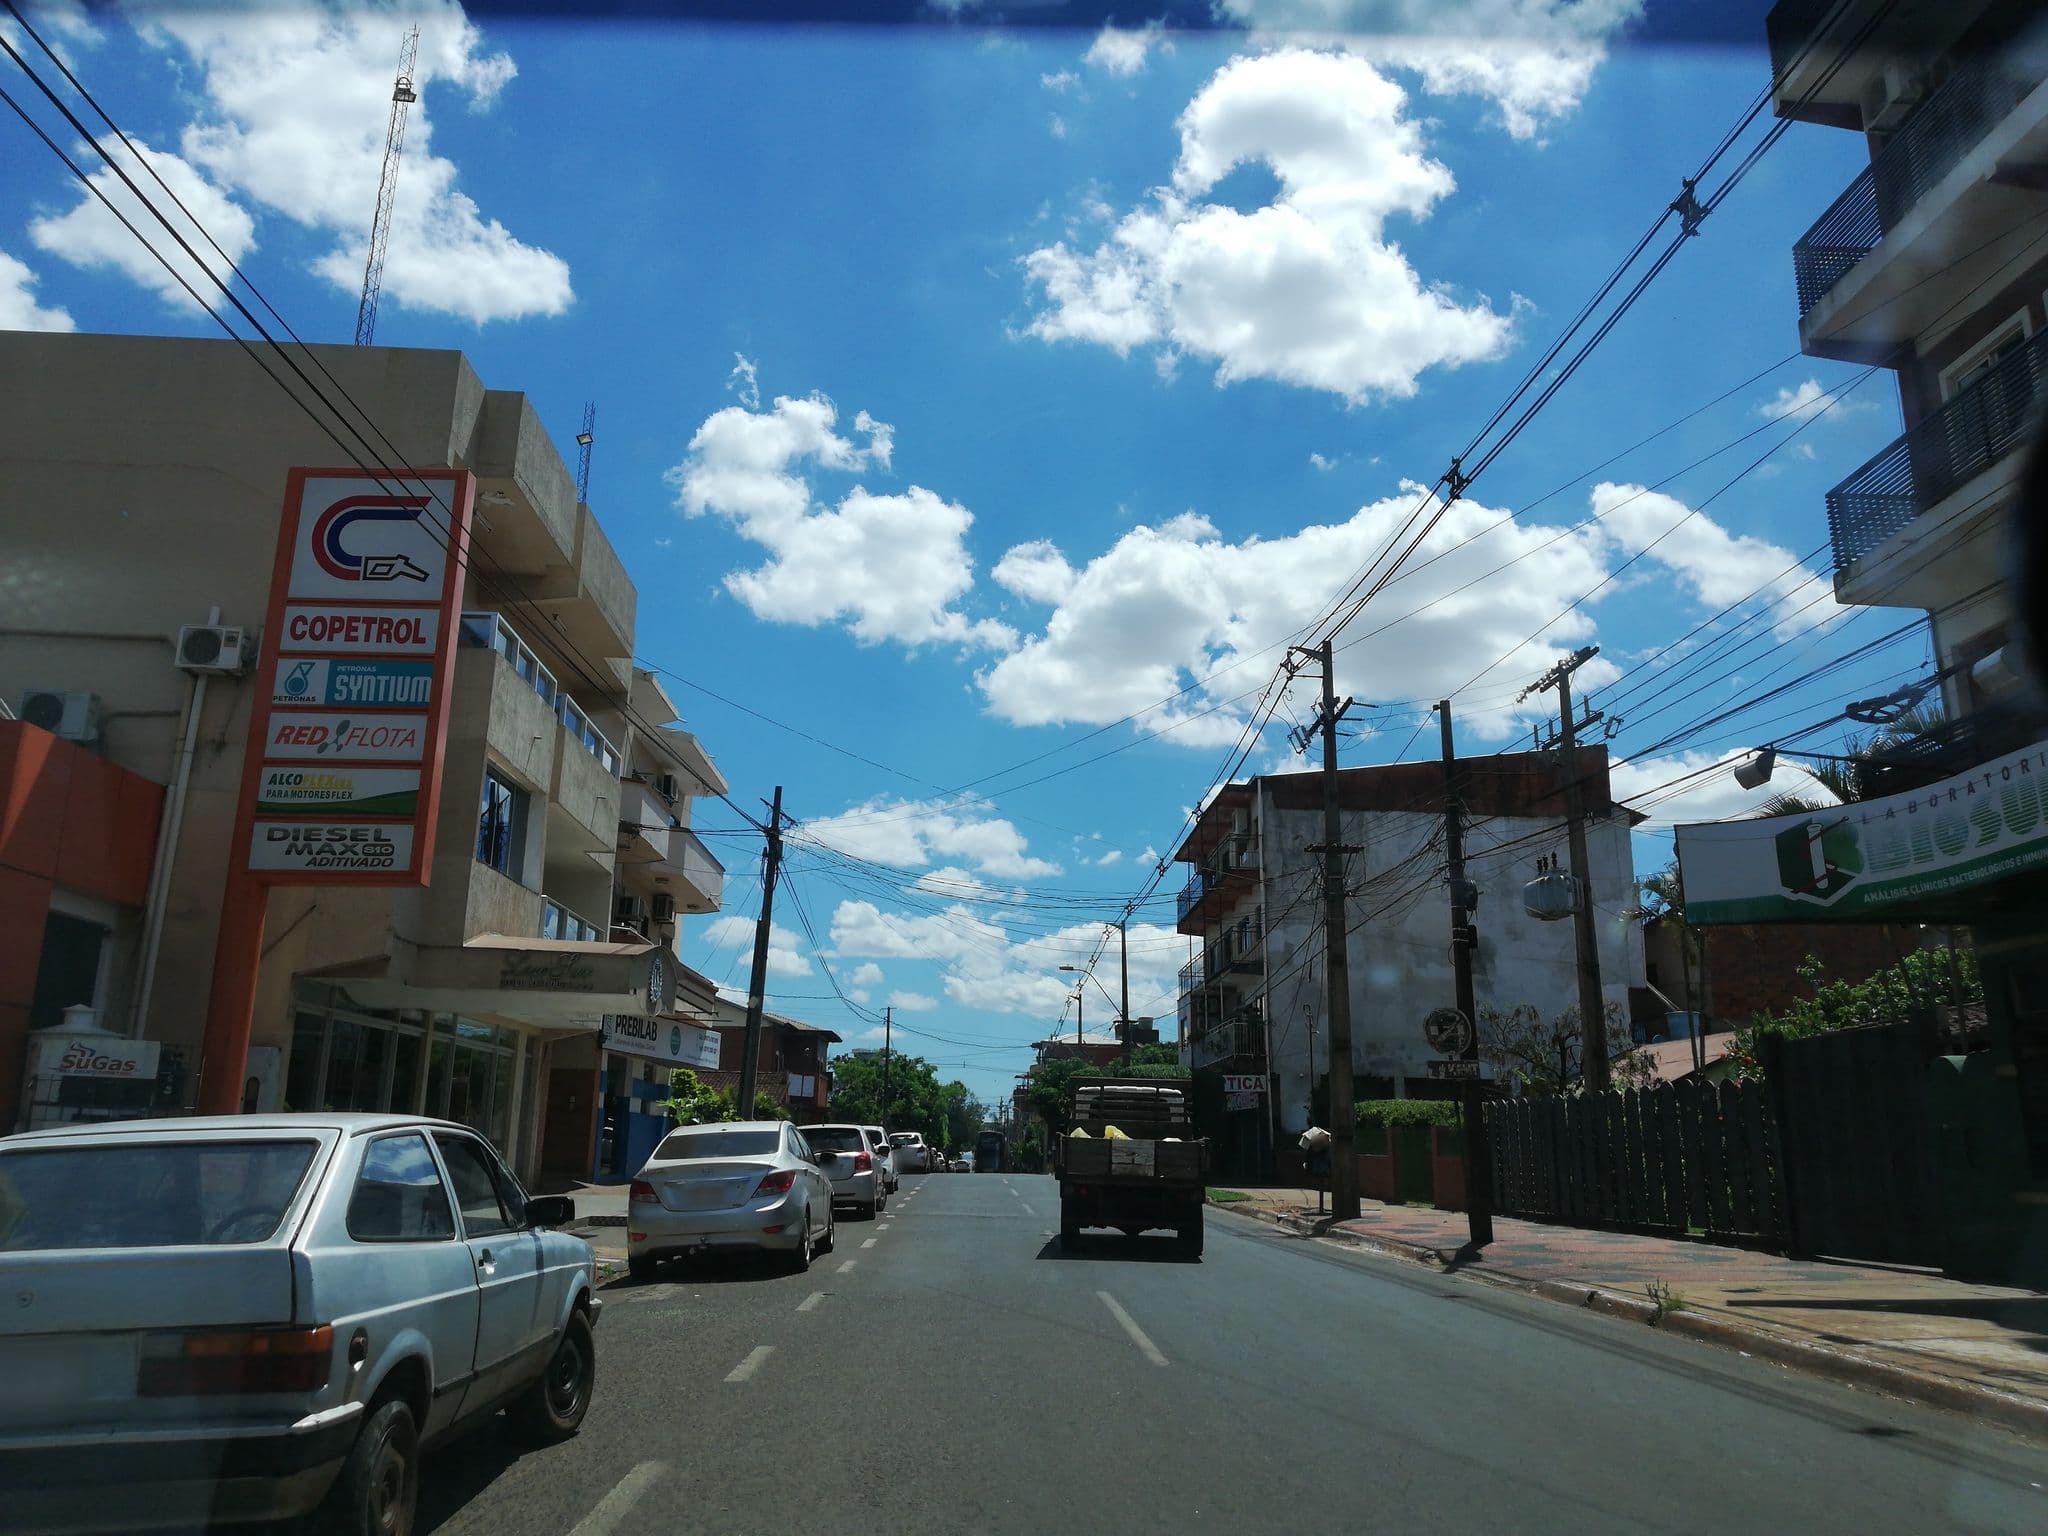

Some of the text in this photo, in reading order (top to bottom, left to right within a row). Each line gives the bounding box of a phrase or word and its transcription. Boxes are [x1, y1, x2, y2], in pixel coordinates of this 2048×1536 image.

[289, 615, 427, 645] COPETROL
[336, 665, 377, 673] PETRONAS
[333, 674, 433, 703] SYNTIUM
[273, 695, 316, 703] PETRONAS
[273, 725, 417, 749] RED FLOTA
[265, 789, 354, 801] PARA MOTORES FLEX
[266, 827, 392, 843] DIESEL
[284, 842, 360, 856] MAX
[304, 857, 395, 868] ADITIVADO
[614, 1013, 658, 1042] PREBILAB
[60, 1053, 137, 1073] SuGas
[1226, 1076, 1265, 1090] TICA
